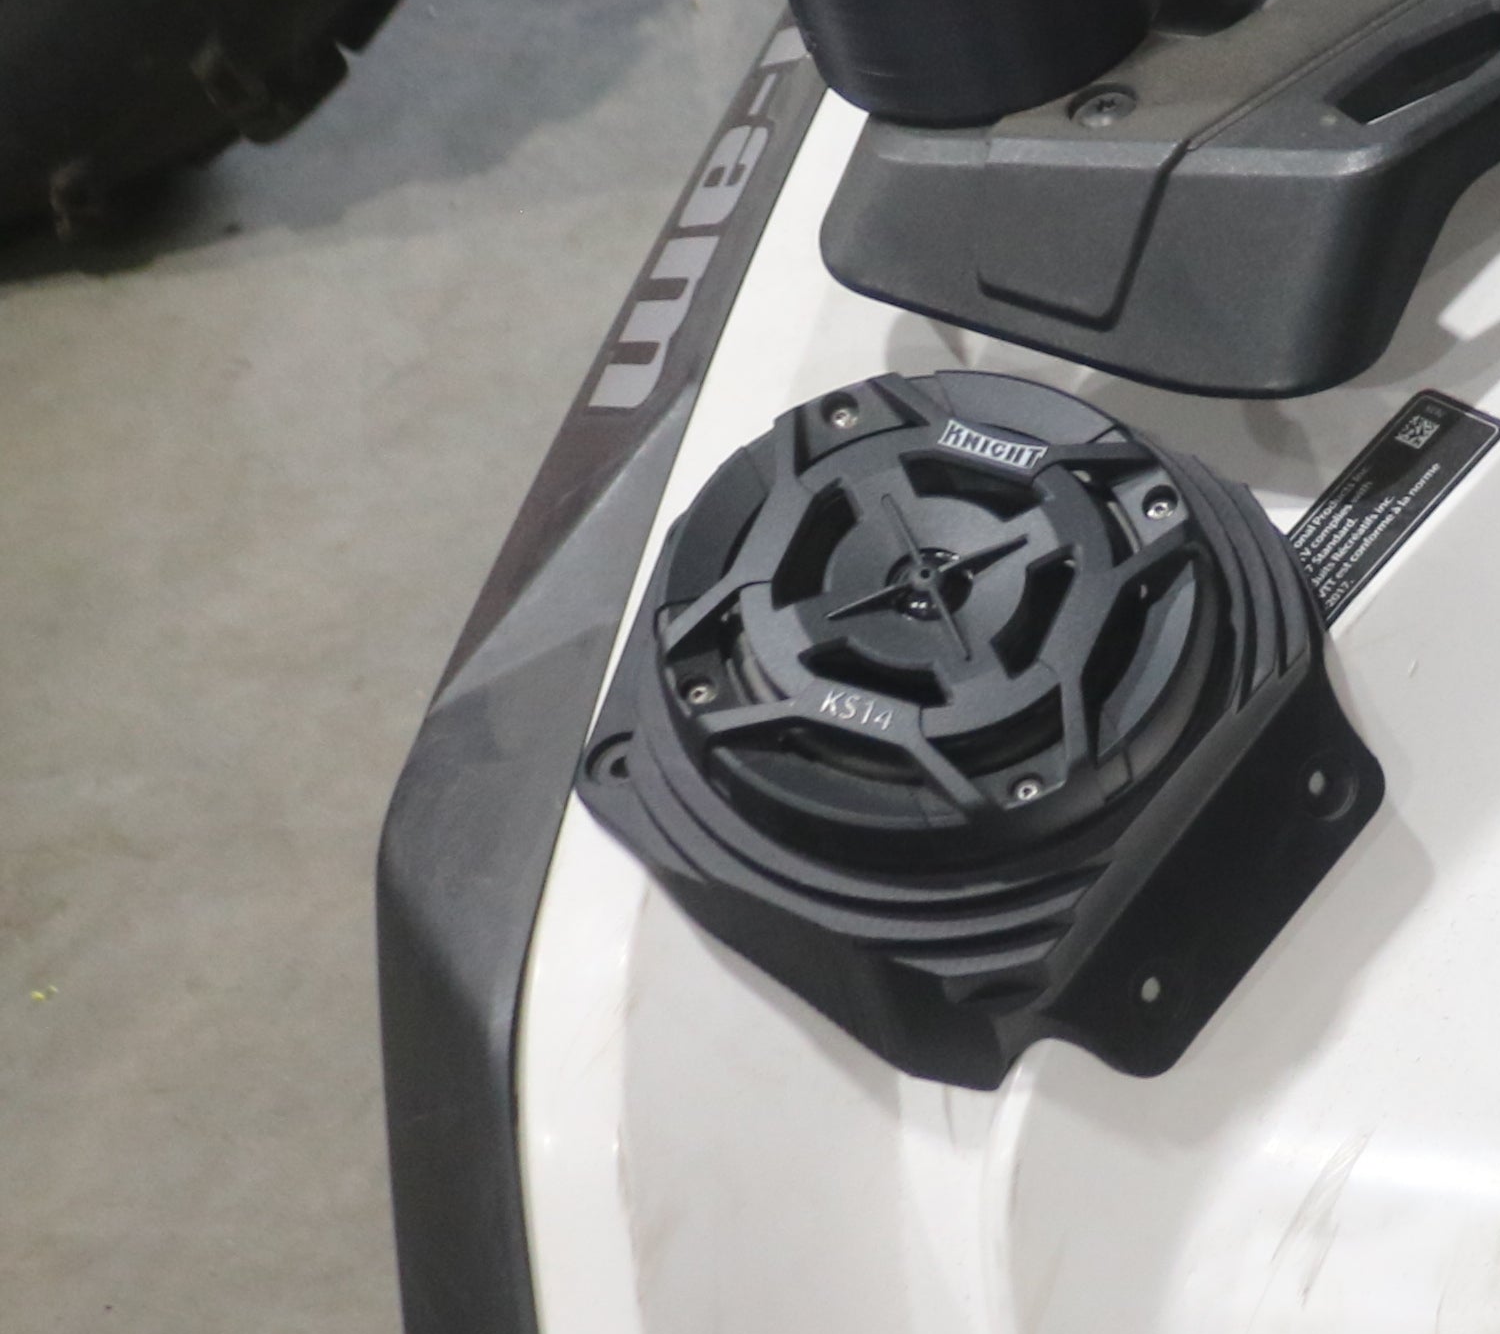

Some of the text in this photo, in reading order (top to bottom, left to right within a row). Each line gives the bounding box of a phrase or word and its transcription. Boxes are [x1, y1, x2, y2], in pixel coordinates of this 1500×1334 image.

[942, 421, 1047, 468] KNIGHT
[1408, 462, 1440, 497] norme
[819, 690, 894, 731] KS14
